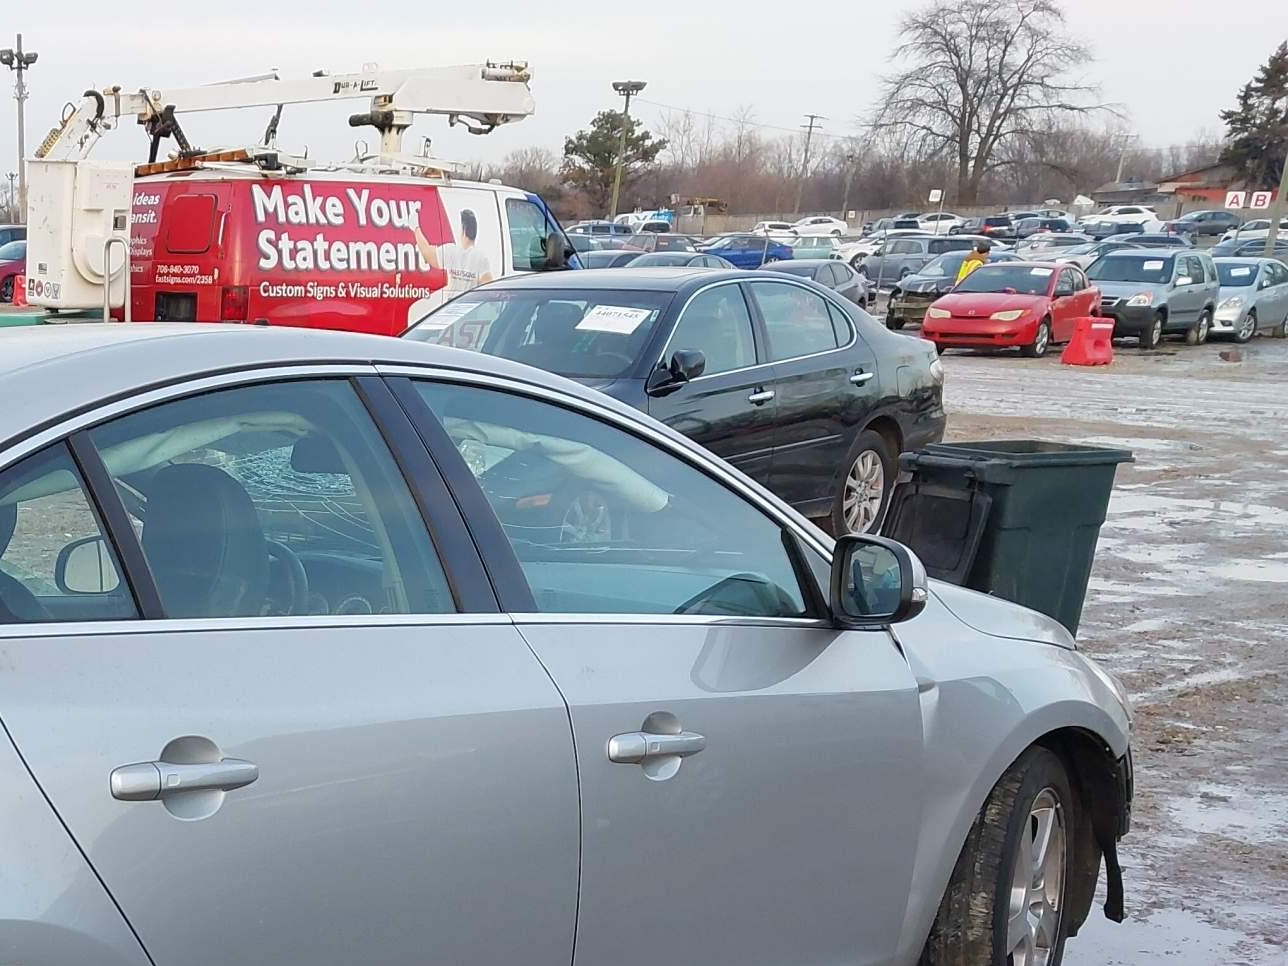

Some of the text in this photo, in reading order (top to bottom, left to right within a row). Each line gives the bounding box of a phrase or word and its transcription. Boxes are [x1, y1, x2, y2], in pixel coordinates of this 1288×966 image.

[133, 192, 160, 205] ideas
[252, 184, 421, 227] Make Your
[1229, 194, 1240, 207] A
[1254, 194, 1267, 207] B
[258, 229, 430, 271] Statement
[260, 281, 430, 300] Custom Signs & Visual Solutions
